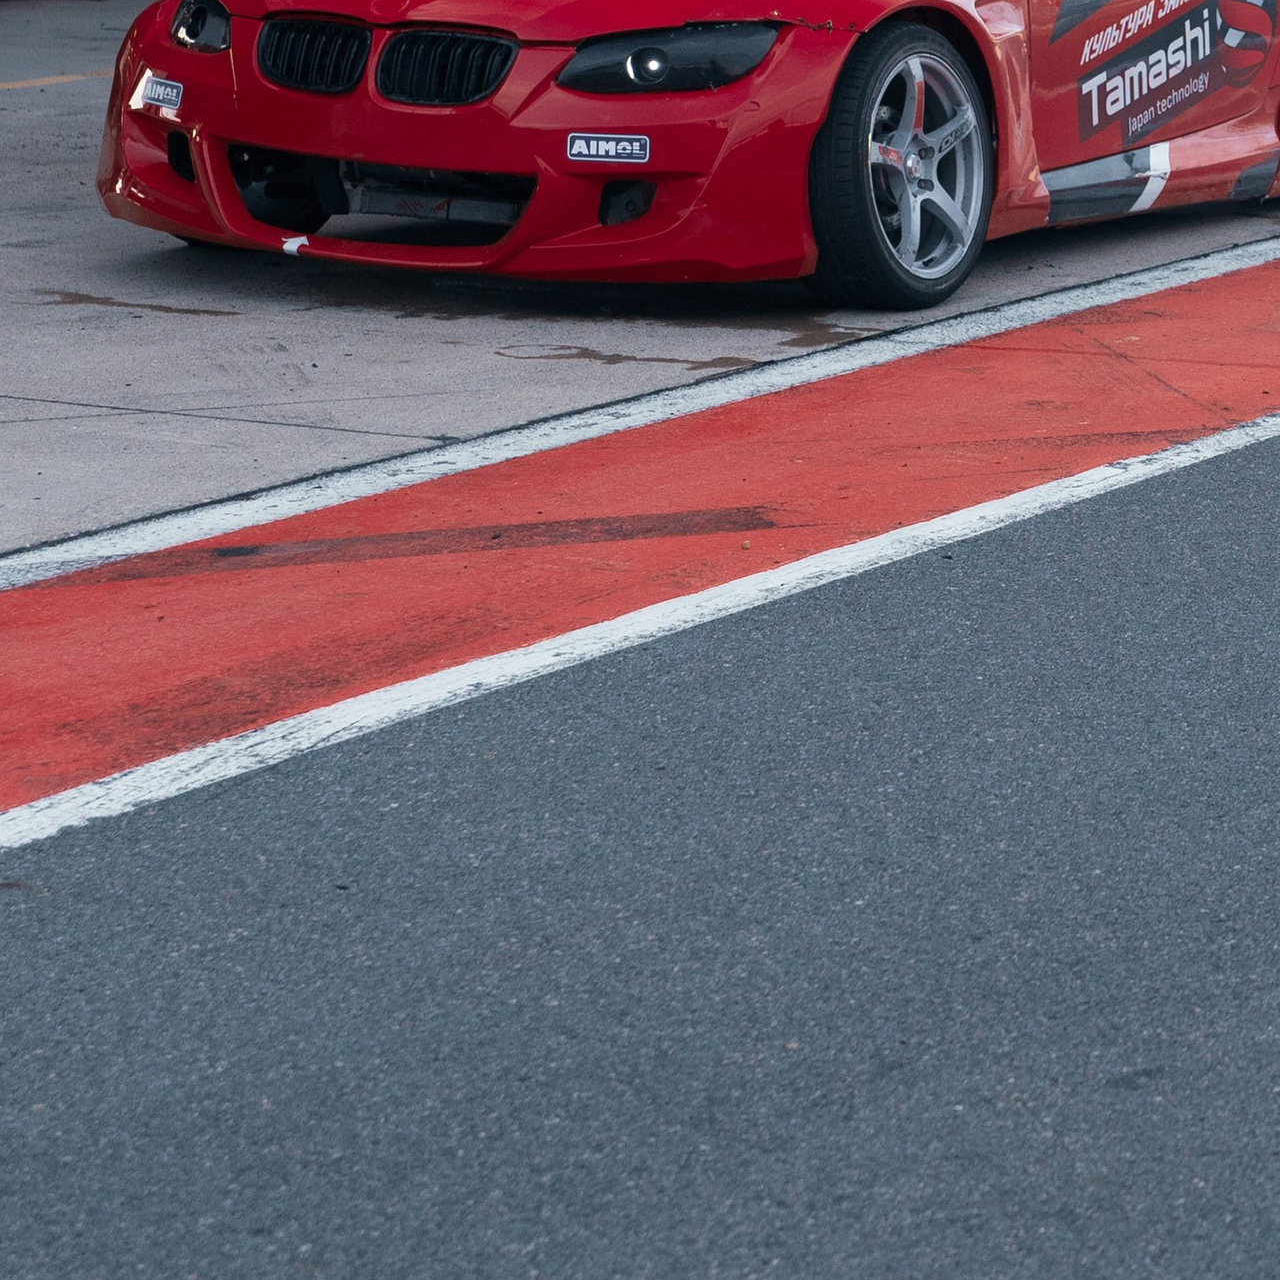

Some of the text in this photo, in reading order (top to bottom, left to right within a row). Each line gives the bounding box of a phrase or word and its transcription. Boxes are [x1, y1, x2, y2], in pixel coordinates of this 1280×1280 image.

[1080, 0, 1156, 66] КУЛЬТУРА
[144, 82, 179, 101] AIMOL
[1081, 7, 1212, 127] Tamashi
[1128, 71, 1210, 137] Japan technology
[570, 139, 646, 157] AIMOL
